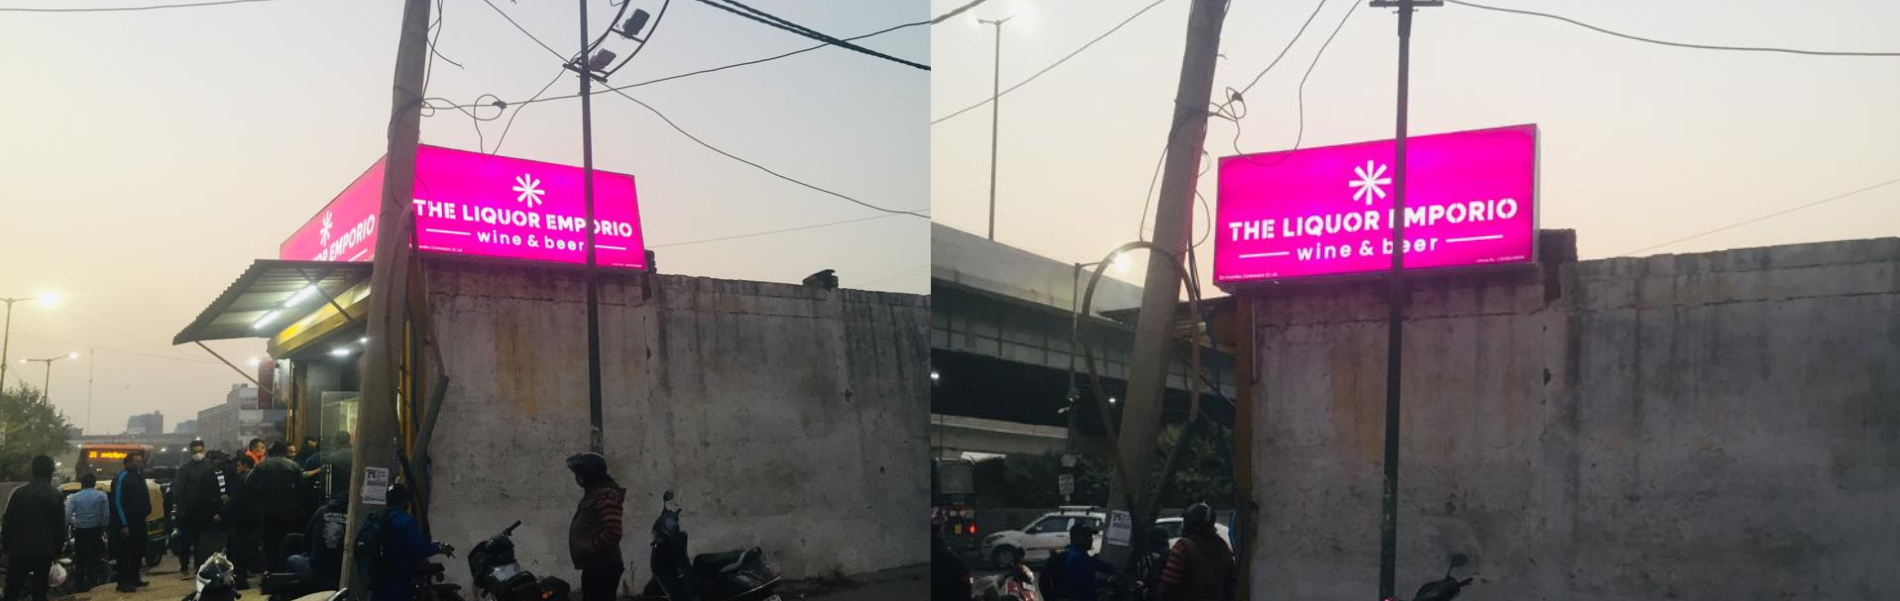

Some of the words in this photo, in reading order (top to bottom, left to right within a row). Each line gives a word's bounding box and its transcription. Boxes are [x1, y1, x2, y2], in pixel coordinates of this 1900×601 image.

[413, 198, 456, 219] THE
[463, 204, 542, 229] LIQUOR
[1229, 217, 1276, 242] THE
[1283, 210, 1380, 238] LIQUOR
[329, 213, 375, 261] EMPORIO
[477, 230, 522, 246] wine
[528, 235, 539, 248] &
[545, 235, 585, 252] beer
[1297, 242, 1352, 261] wine
[1360, 240, 1374, 256] &
[1383, 237, 1438, 255] beer
